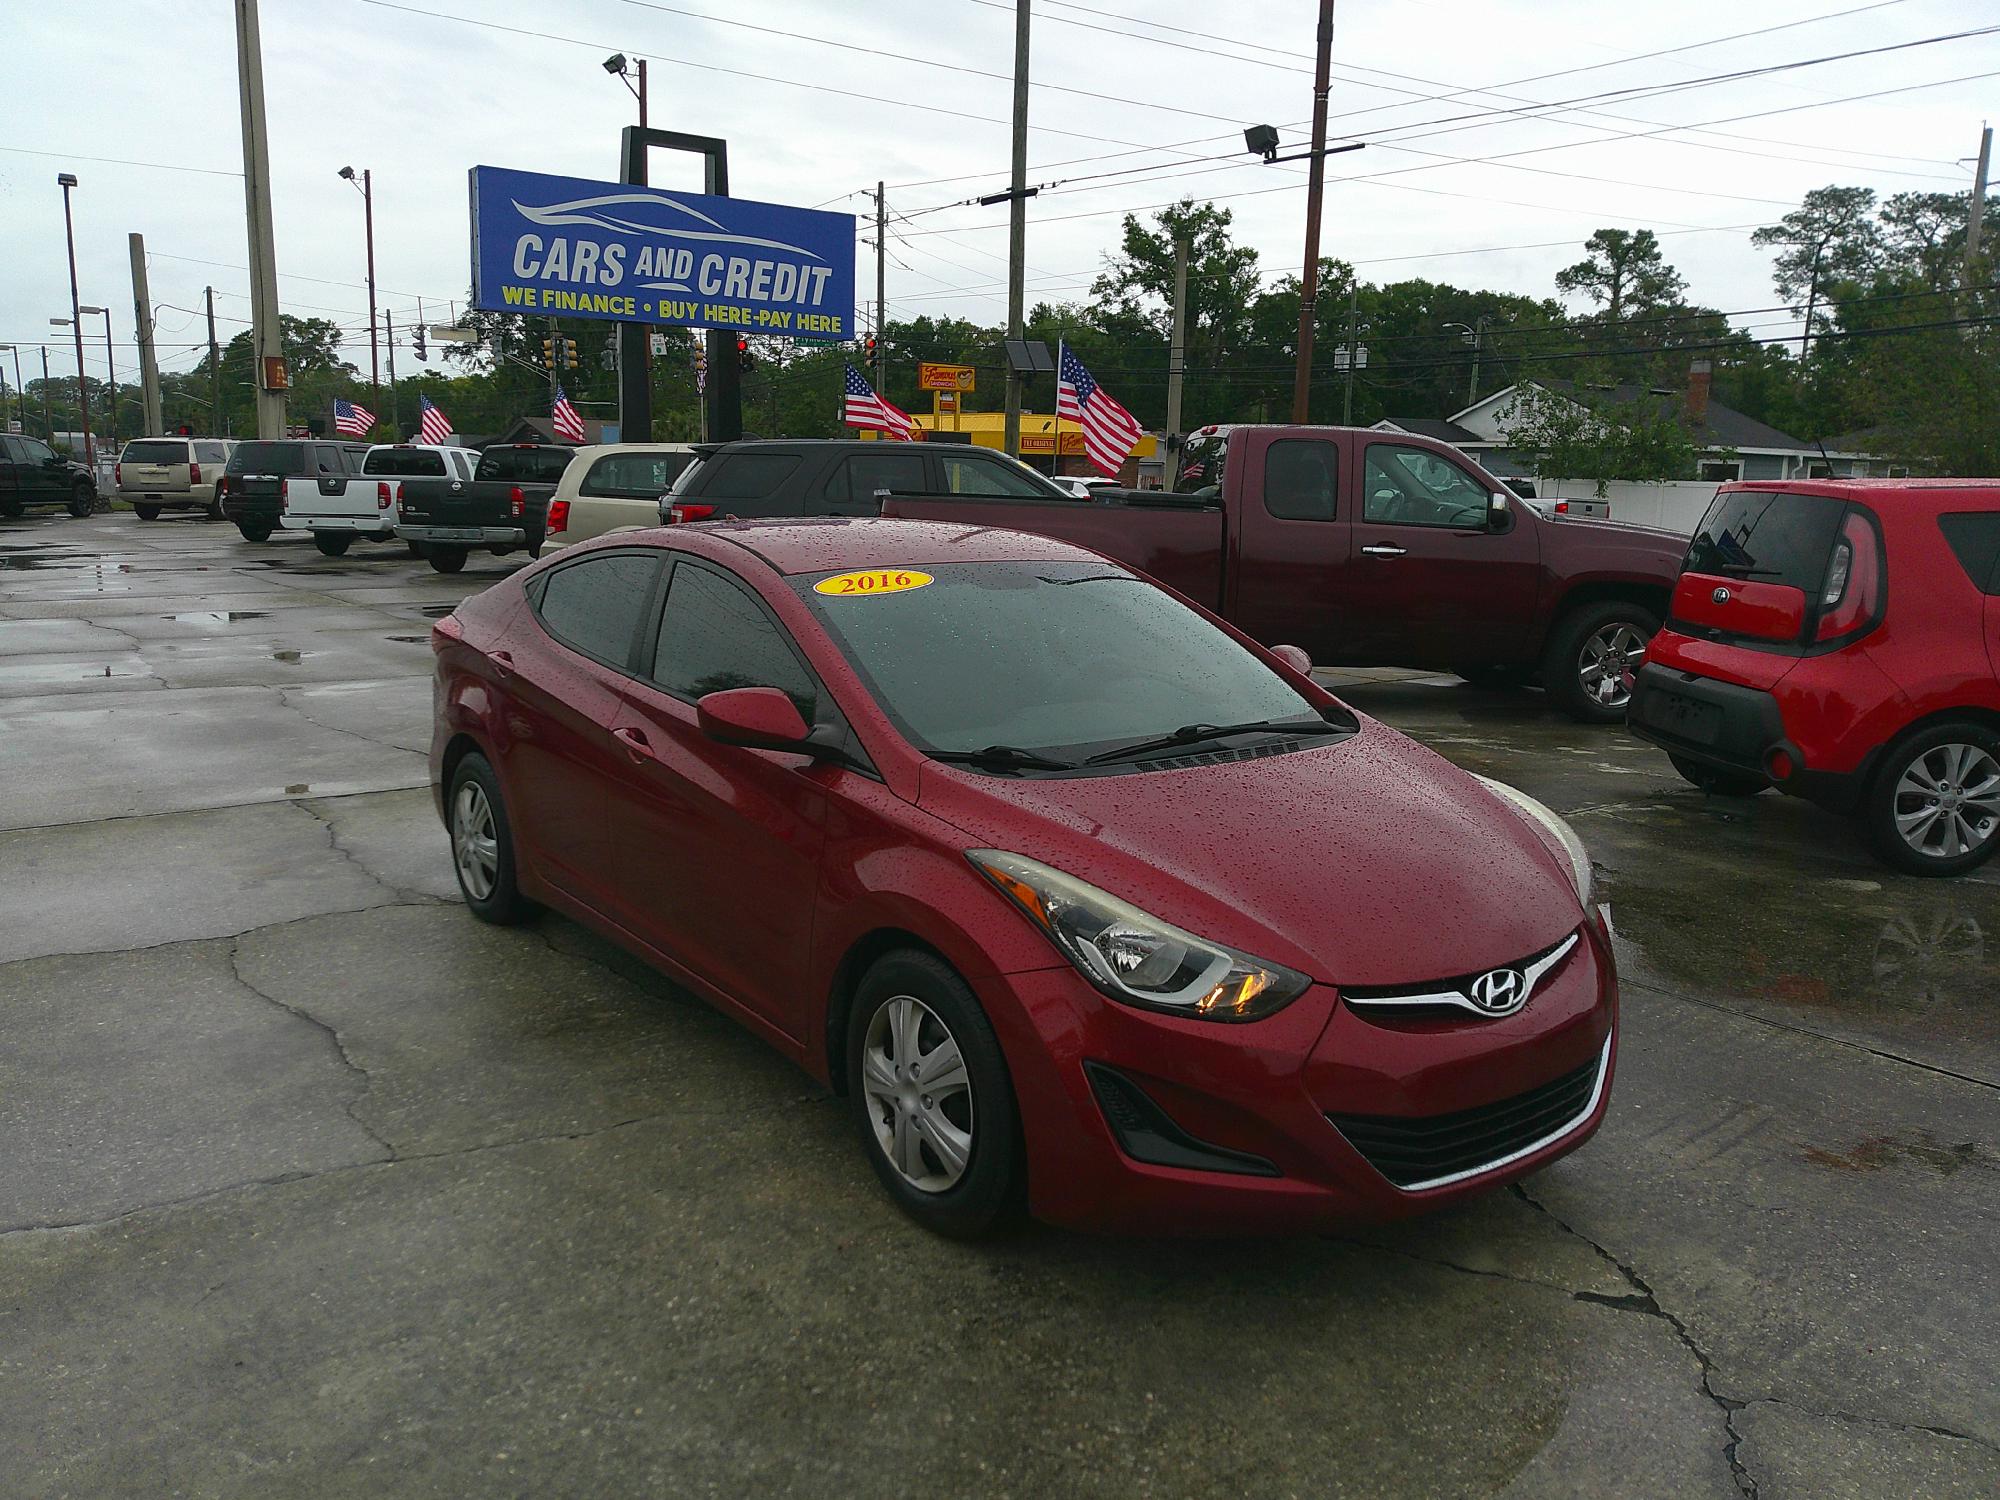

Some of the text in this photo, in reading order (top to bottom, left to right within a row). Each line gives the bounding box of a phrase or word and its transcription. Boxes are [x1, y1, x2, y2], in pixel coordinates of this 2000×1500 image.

[513, 233, 833, 306] CARS AND CREDIT
[502, 285, 537, 307] WE
[542, 289, 636, 315] FINANCE
[659, 300, 699, 319] BUY
[797, 312, 842, 334] HERE
[1022, 439, 1055, 448] THE ORIGINAL
[840, 572, 912, 592] 2016
